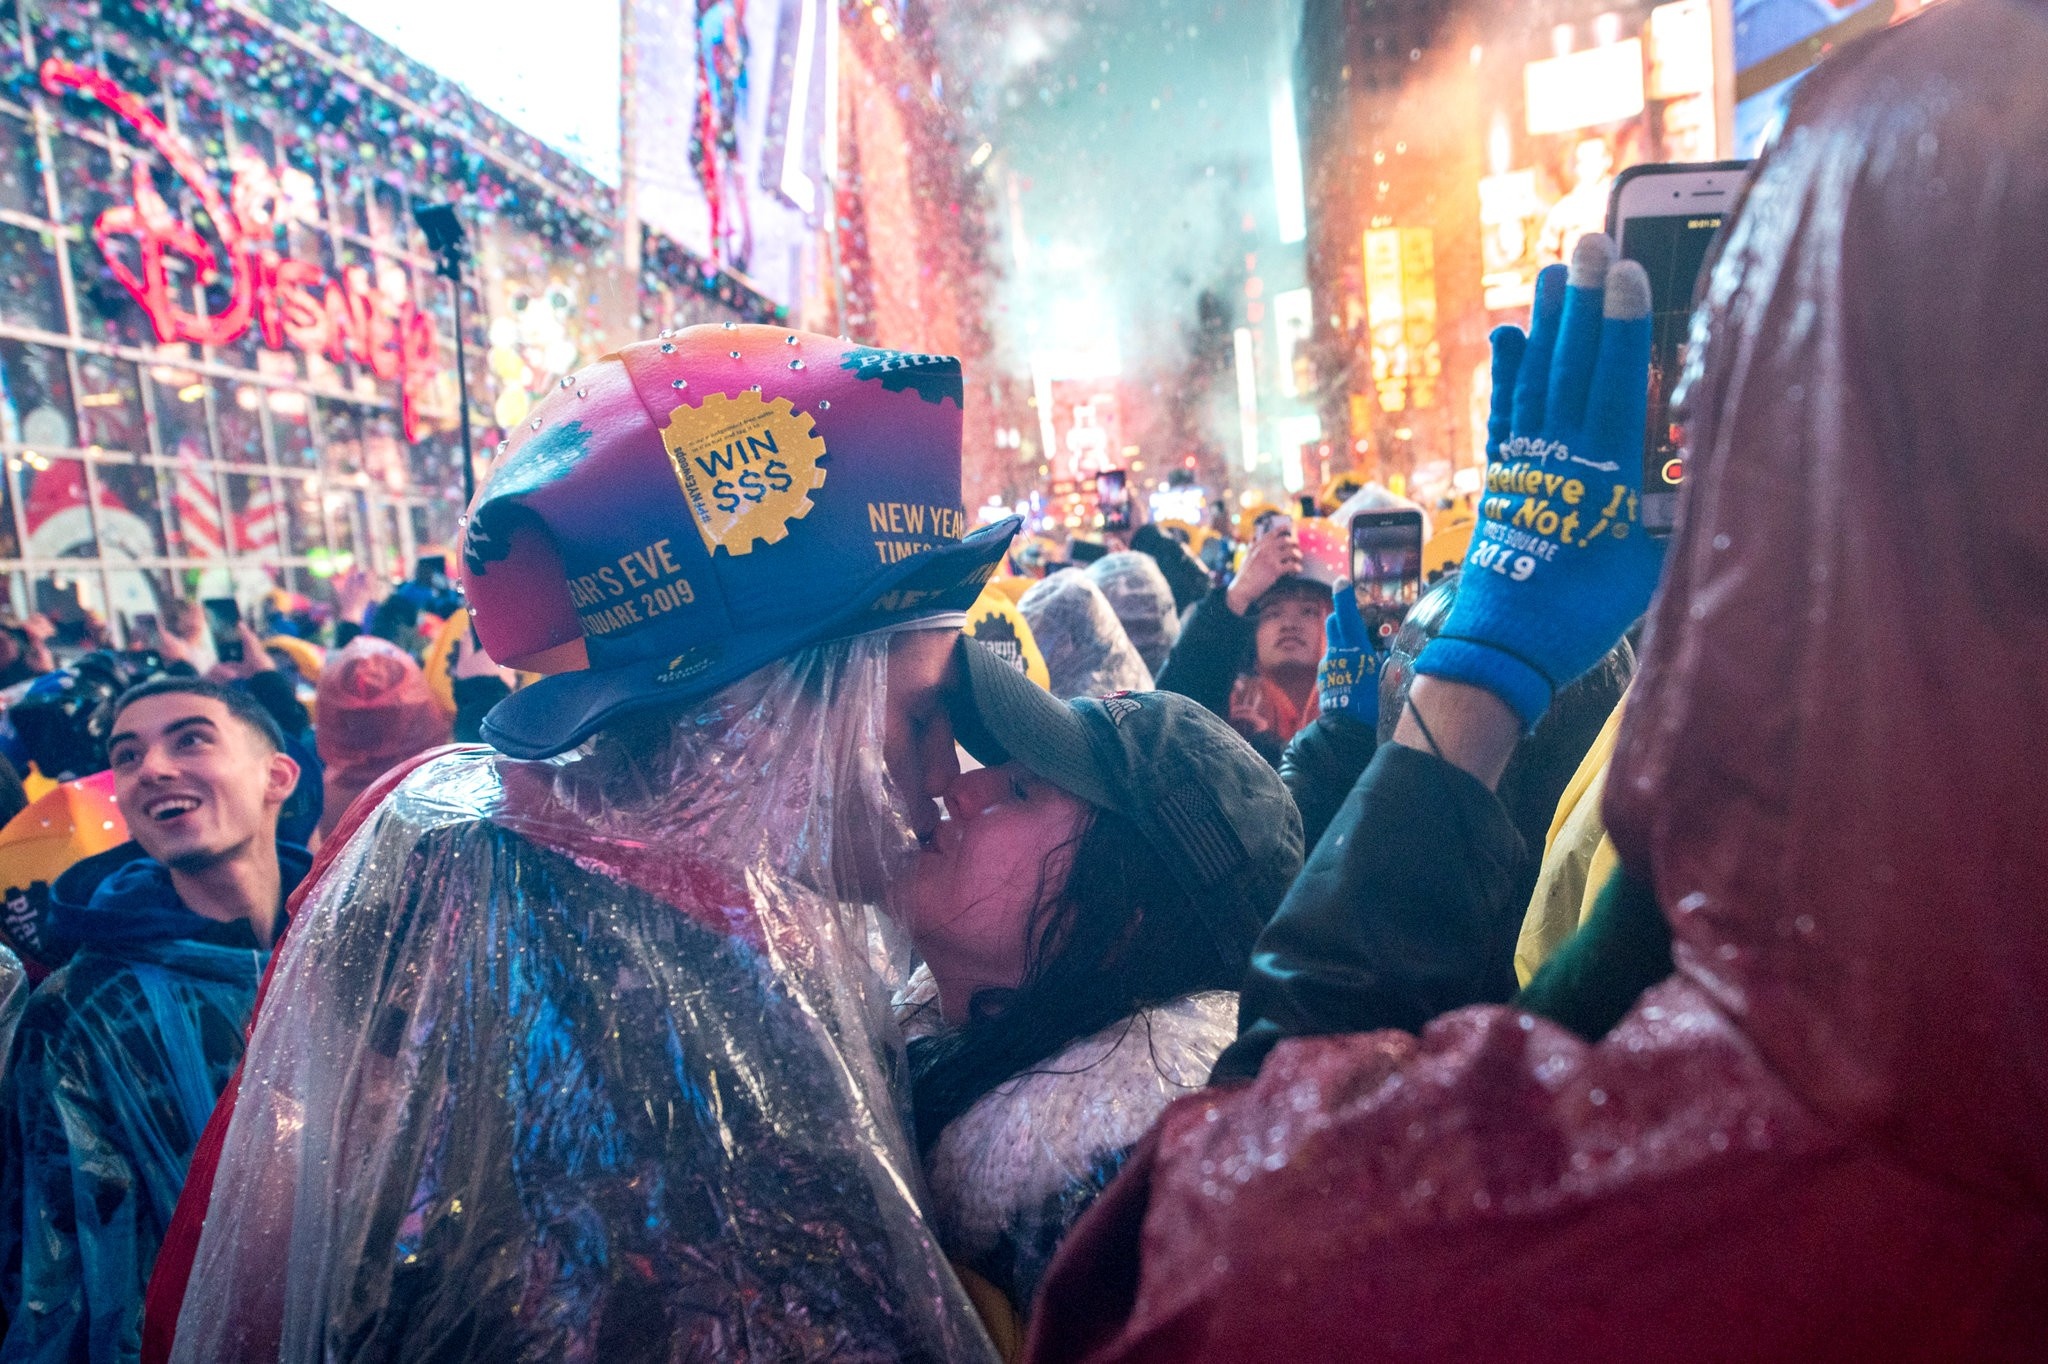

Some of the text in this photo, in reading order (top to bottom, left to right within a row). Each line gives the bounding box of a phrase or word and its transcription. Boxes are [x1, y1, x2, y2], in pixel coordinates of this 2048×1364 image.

[695, 429, 779, 478] WIN
[712, 459, 793, 513] $$$
[1484, 496, 1512, 520] or
[1487, 461, 1638, 522] Believe It
[867, 502, 925, 534] NEW
[617, 538, 682, 589] EVE
[1469, 540, 1537, 581] 2019
[641, 578, 695, 618] 2019
